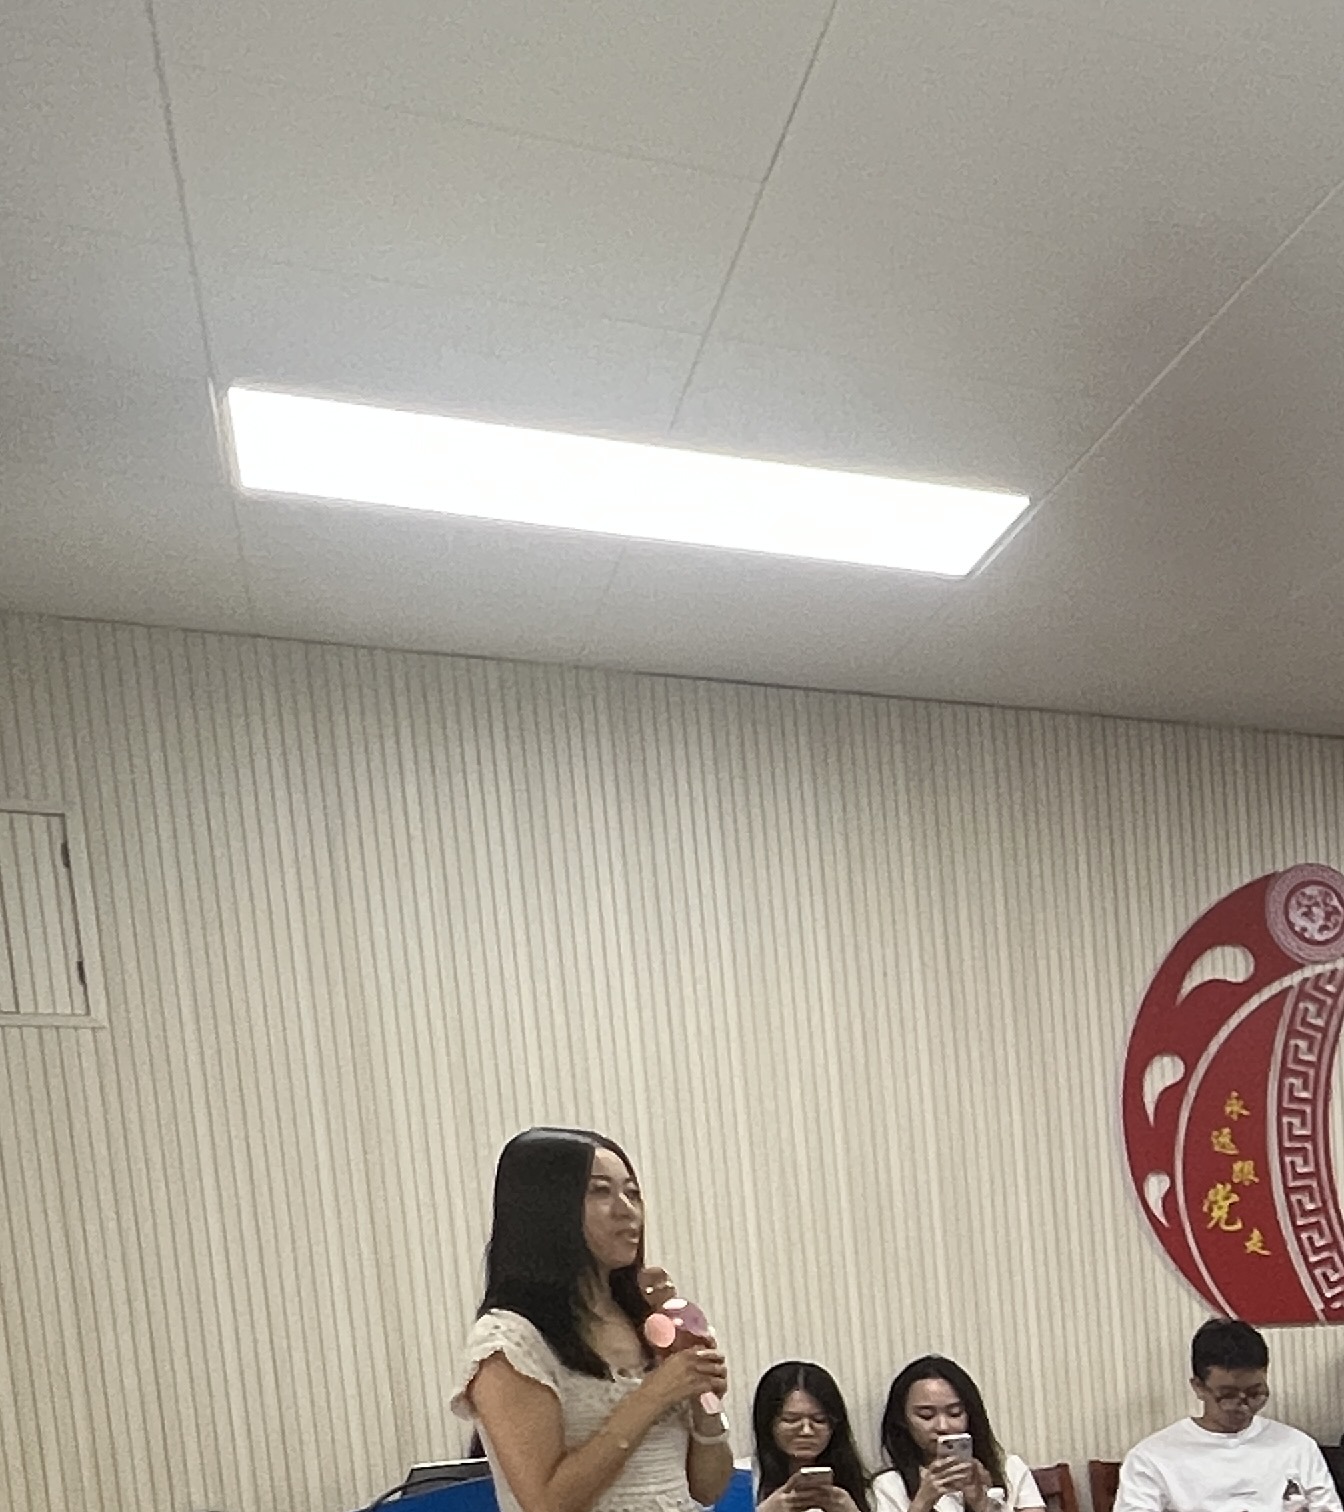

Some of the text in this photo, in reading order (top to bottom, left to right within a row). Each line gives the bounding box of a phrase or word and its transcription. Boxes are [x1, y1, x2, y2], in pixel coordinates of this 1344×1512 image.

[1203, 1090, 1271, 1256] 永远跟党走
